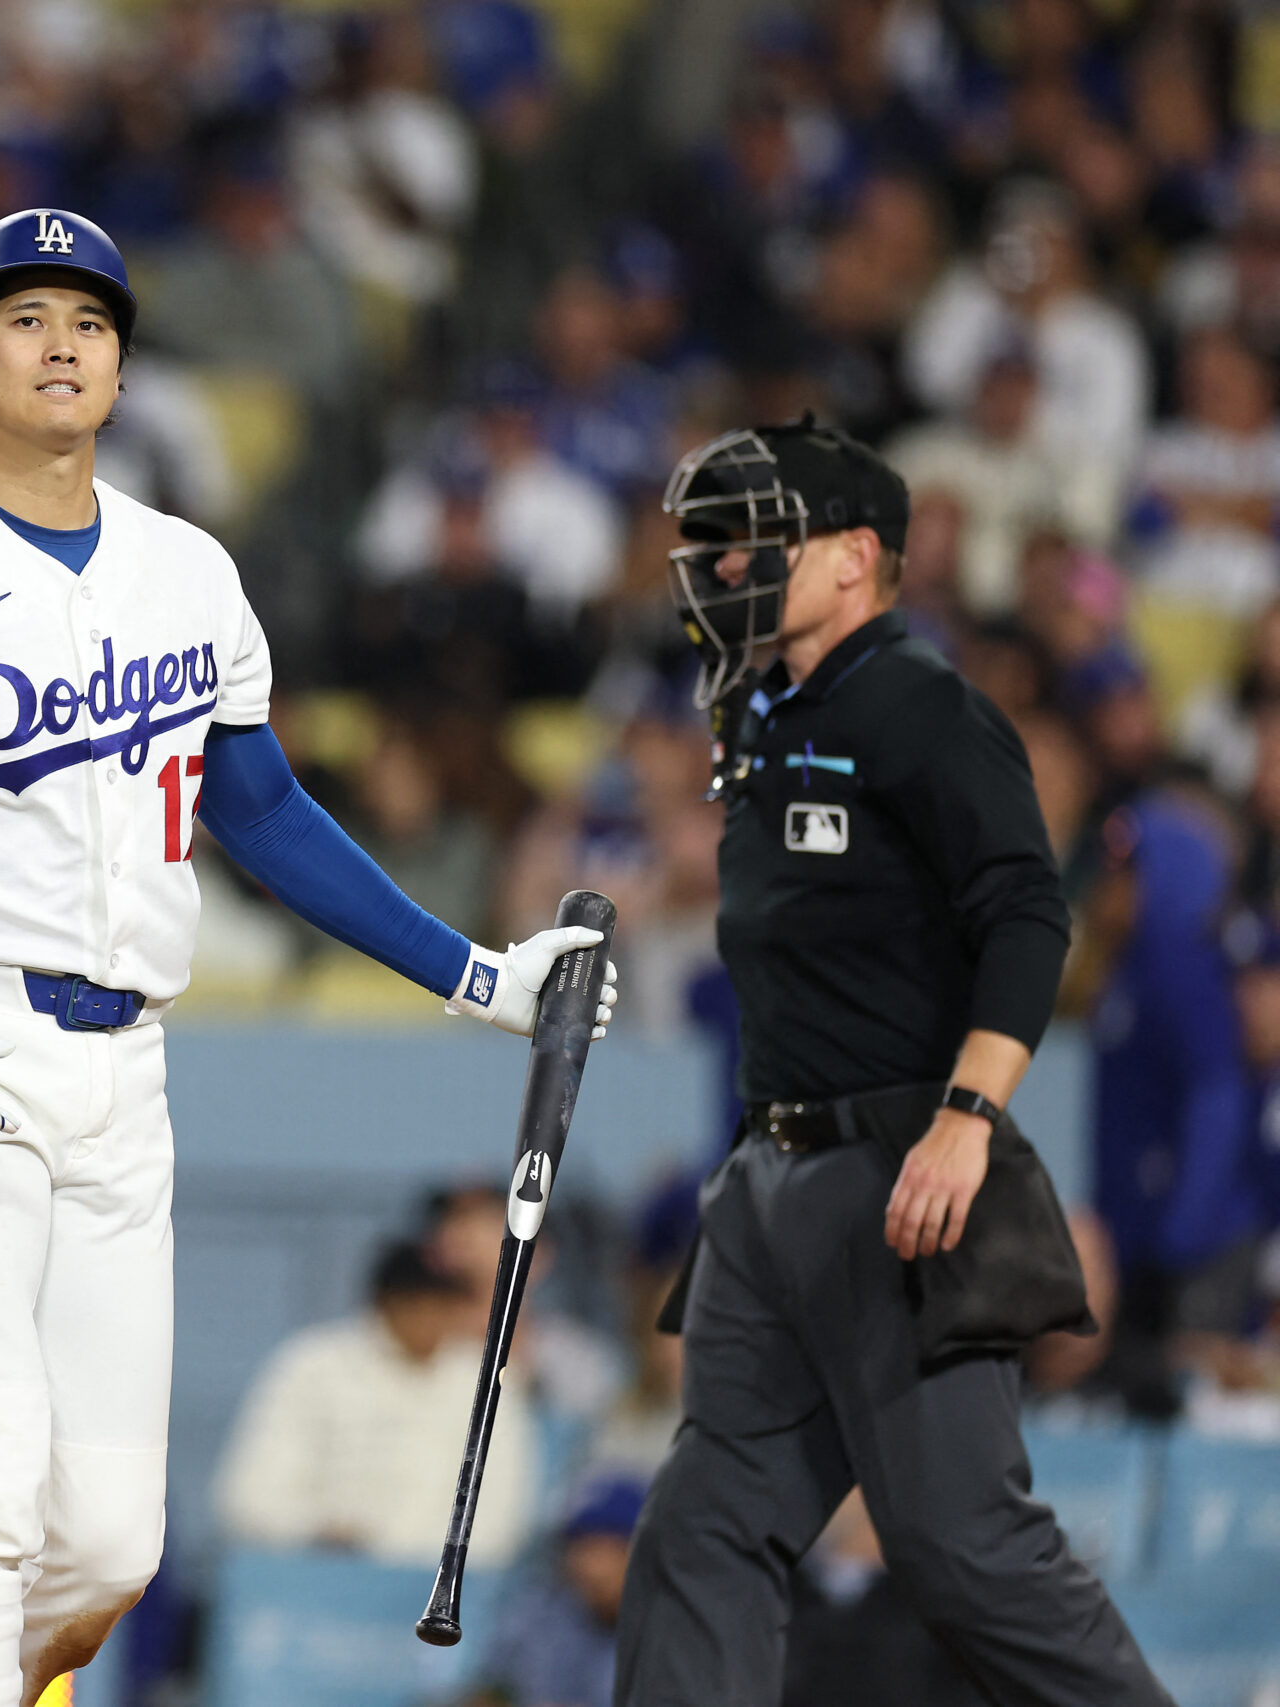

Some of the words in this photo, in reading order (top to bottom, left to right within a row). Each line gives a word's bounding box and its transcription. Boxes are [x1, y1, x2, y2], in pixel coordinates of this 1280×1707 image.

[34, 211, 73, 254] LA
[557, 970, 568, 992] MODEL
[570, 961, 583, 989] SHOHEI
